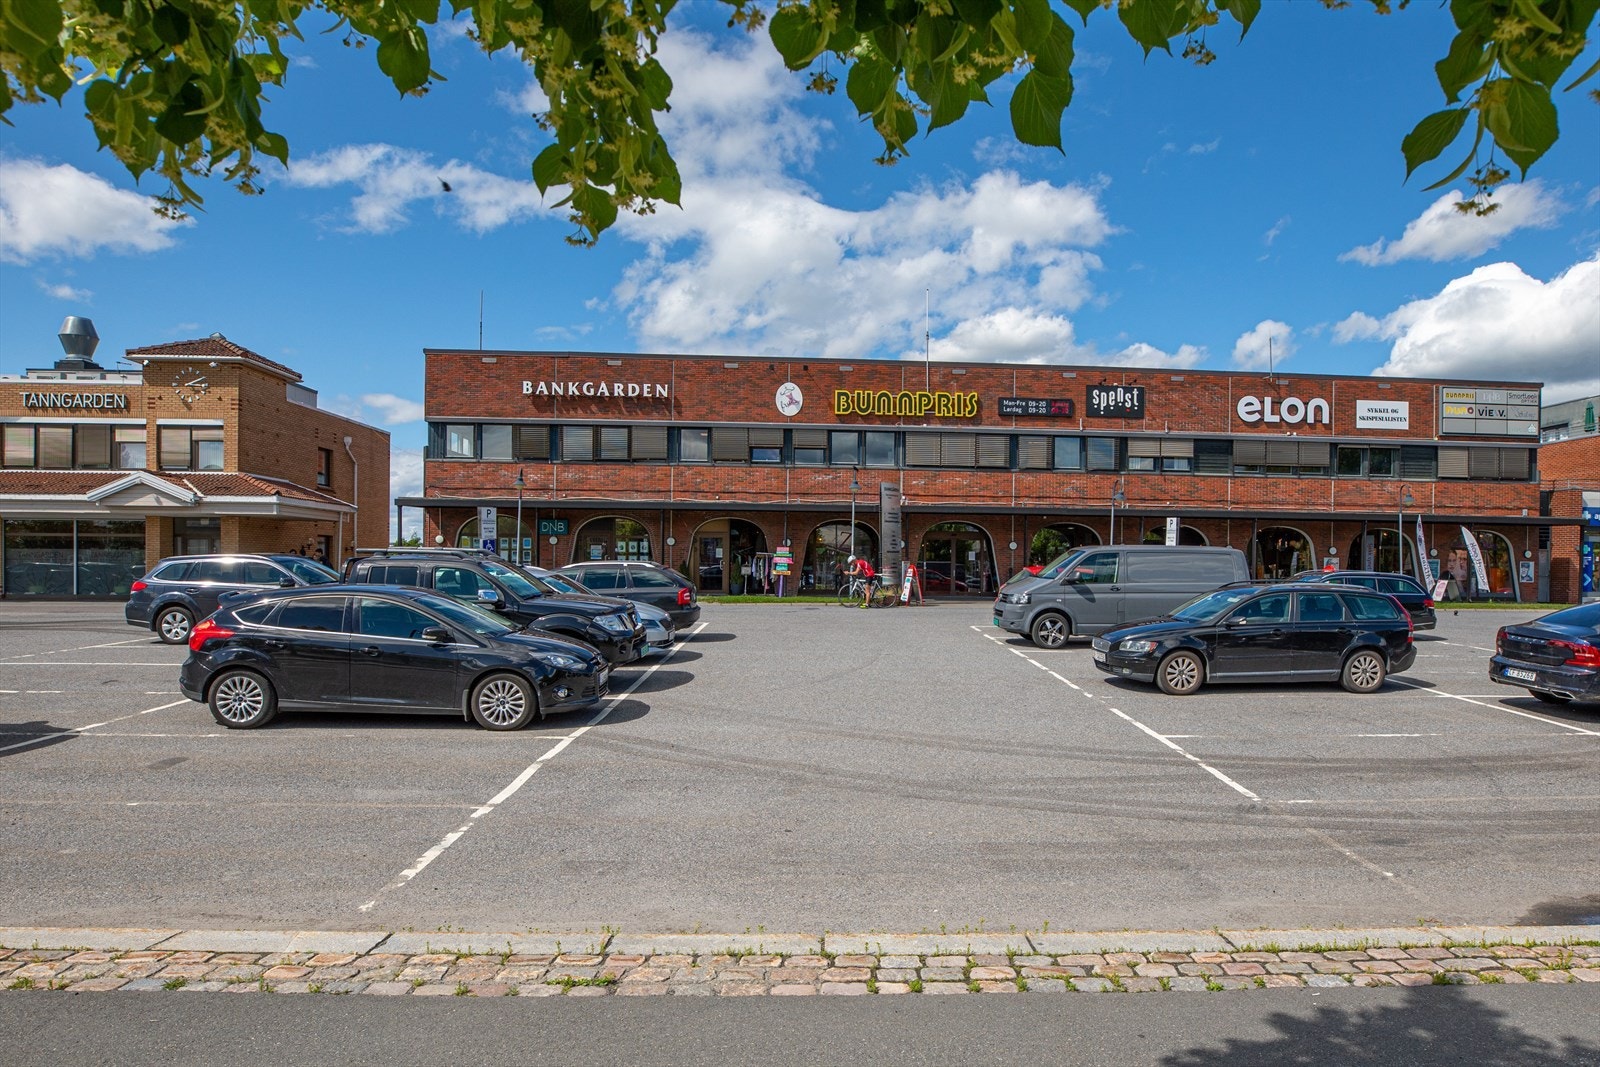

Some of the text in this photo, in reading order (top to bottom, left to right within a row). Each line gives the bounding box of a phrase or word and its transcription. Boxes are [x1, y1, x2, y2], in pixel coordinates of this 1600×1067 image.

[20, 392, 125, 408] TANNGARDEN
[1366, 407, 1391, 415] SYKKEL
[1358, 414, 1409, 424] SKISPESIALISTEN
[486, 509, 492, 519] P
[541, 520, 565, 535] DNB
[1169, 519, 1174, 528] P
